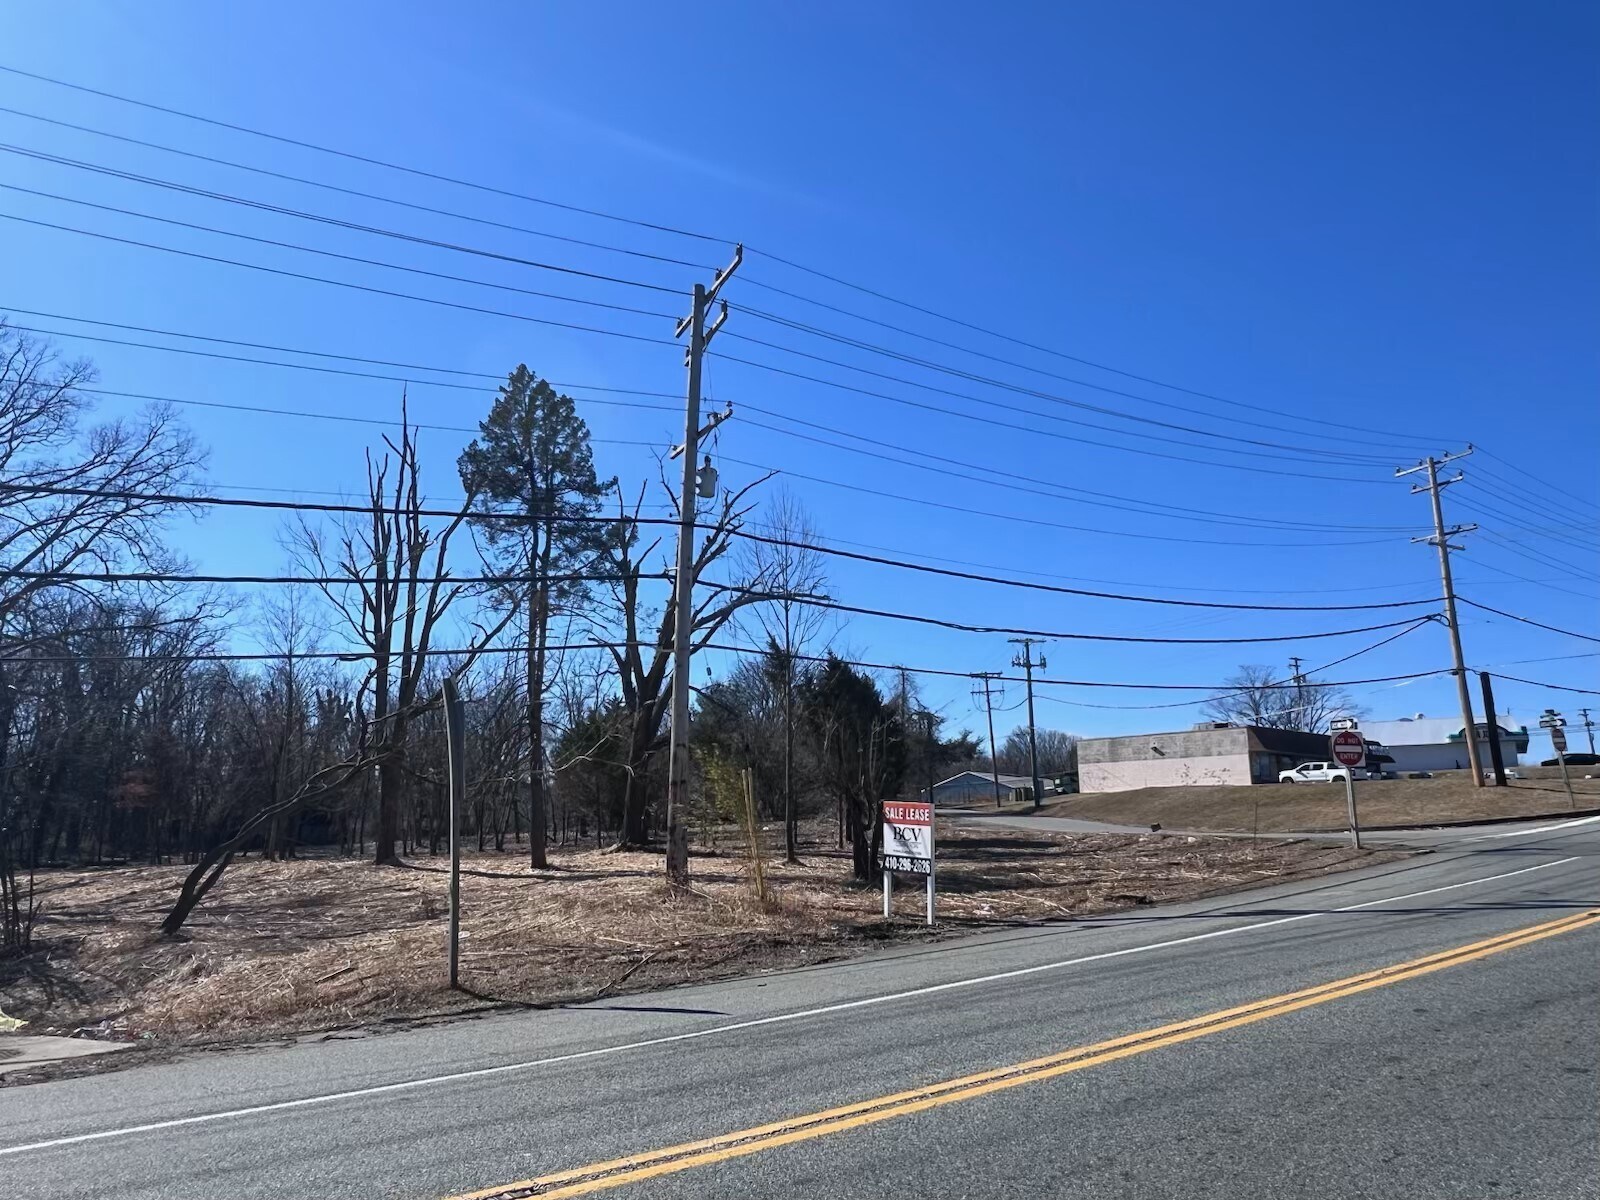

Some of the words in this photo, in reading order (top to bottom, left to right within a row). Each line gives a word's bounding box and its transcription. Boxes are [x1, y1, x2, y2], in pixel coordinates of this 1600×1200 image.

[1347, 737, 1359, 745] NOT
[885, 807, 904, 820] SALE
[906, 808, 930, 821] LEASE
[893, 826, 922, 842] BCV
